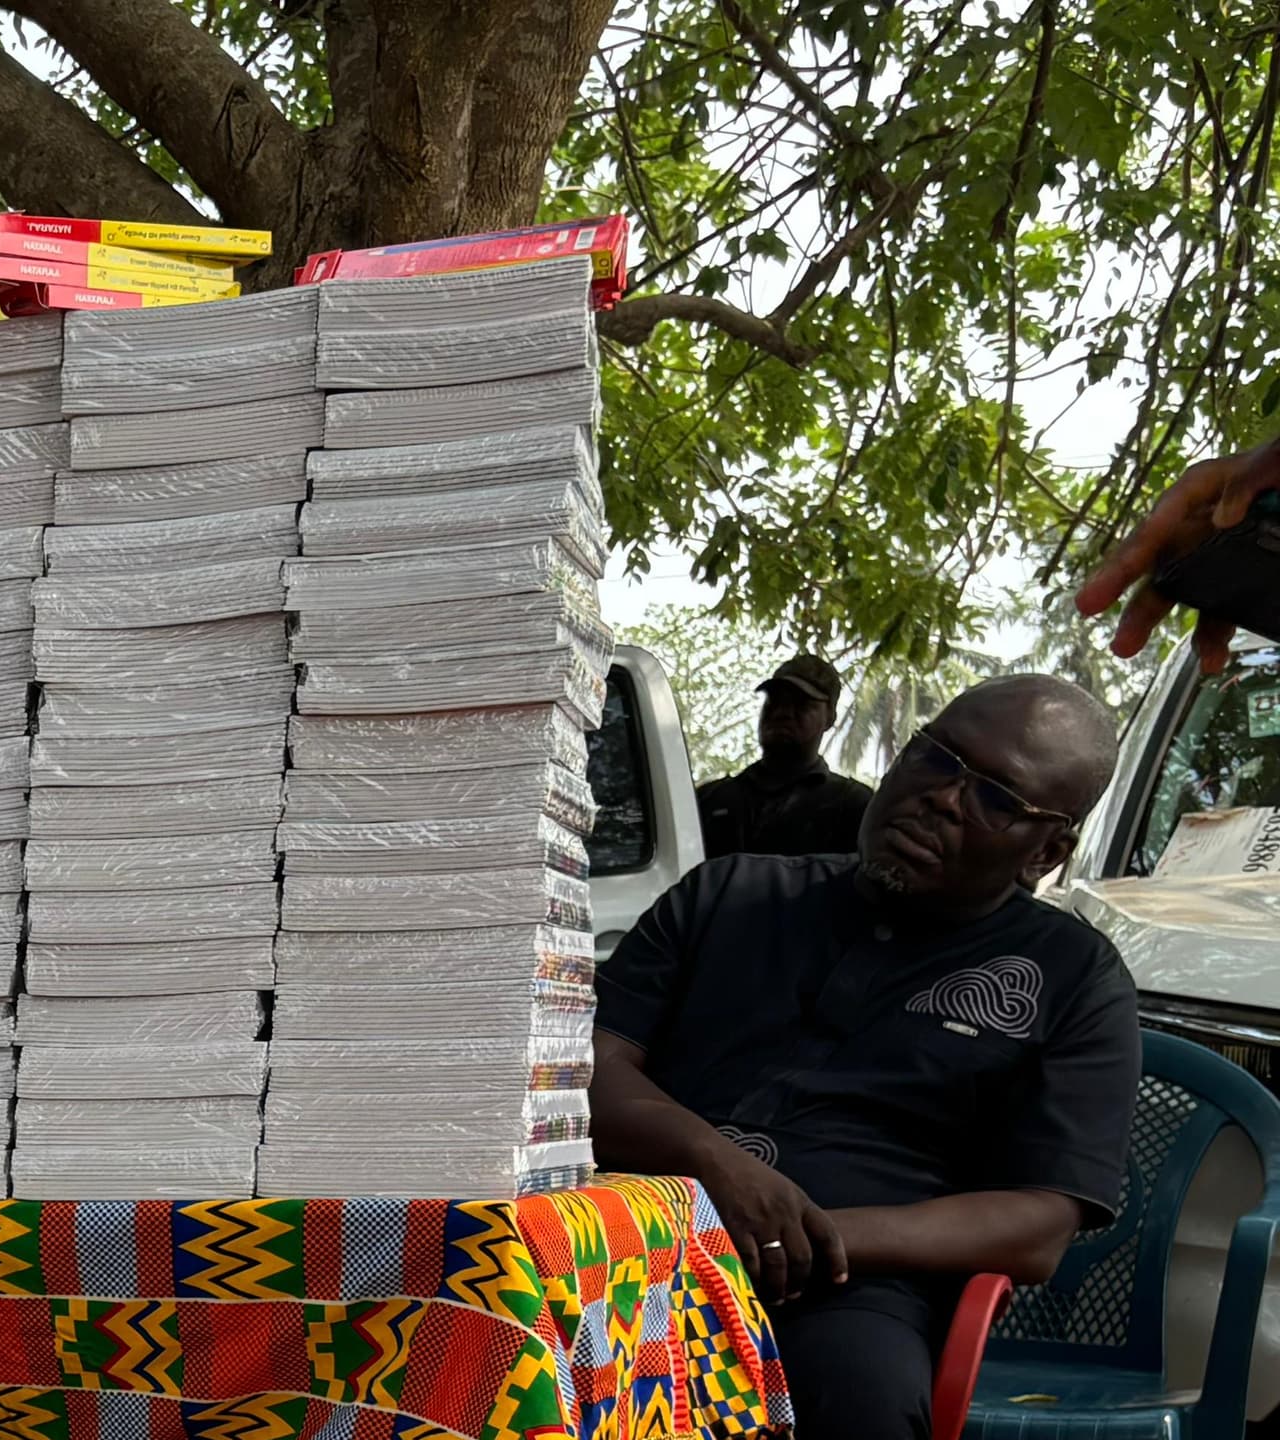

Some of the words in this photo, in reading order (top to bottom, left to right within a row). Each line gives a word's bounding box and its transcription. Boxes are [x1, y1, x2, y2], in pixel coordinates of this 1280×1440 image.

[27, 222, 72, 234] NATARAJ
[23, 240, 63, 254] NATARAJ
[20, 264, 61, 277] NATARAJ
[74, 293, 116, 305] NATARAJ
